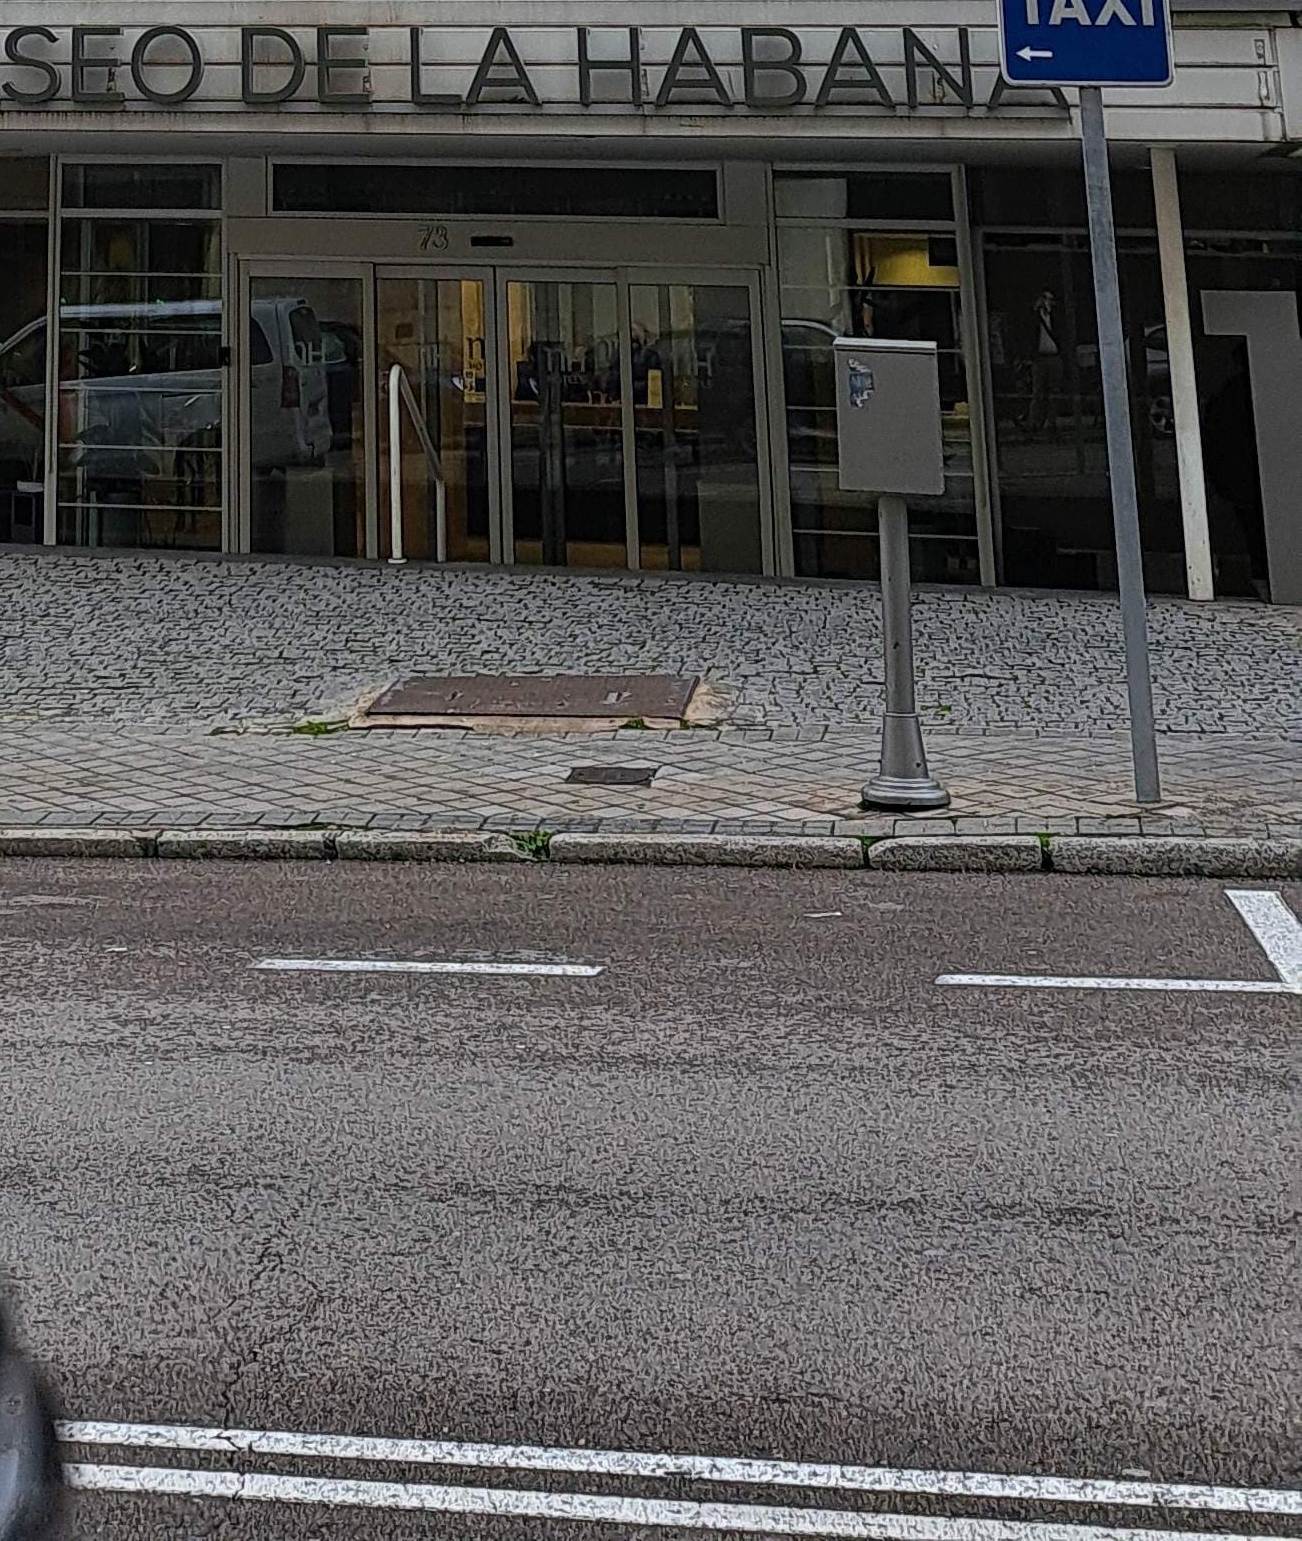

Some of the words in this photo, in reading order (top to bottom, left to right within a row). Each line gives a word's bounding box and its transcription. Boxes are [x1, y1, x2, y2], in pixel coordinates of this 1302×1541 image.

[241, 25, 370, 106] DE
[409, 26, 544, 107] LA
[417, 224, 449, 251] 73
